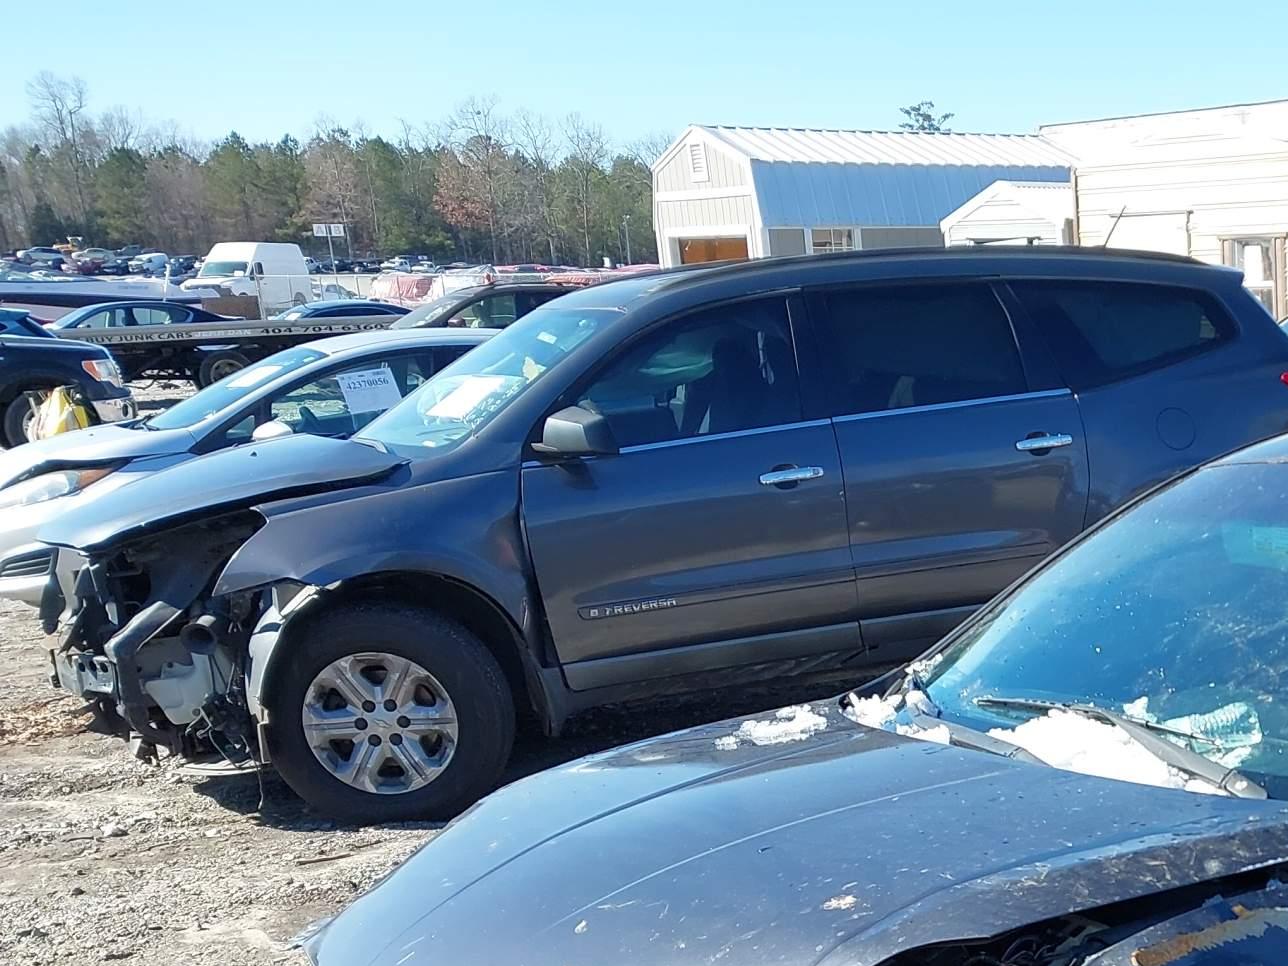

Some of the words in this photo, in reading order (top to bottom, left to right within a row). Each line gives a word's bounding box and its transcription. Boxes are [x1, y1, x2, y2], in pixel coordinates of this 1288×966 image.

[118, 334, 153, 342] JUNK
[158, 332, 193, 340] CARS
[346, 378, 389, 390] 42370056
